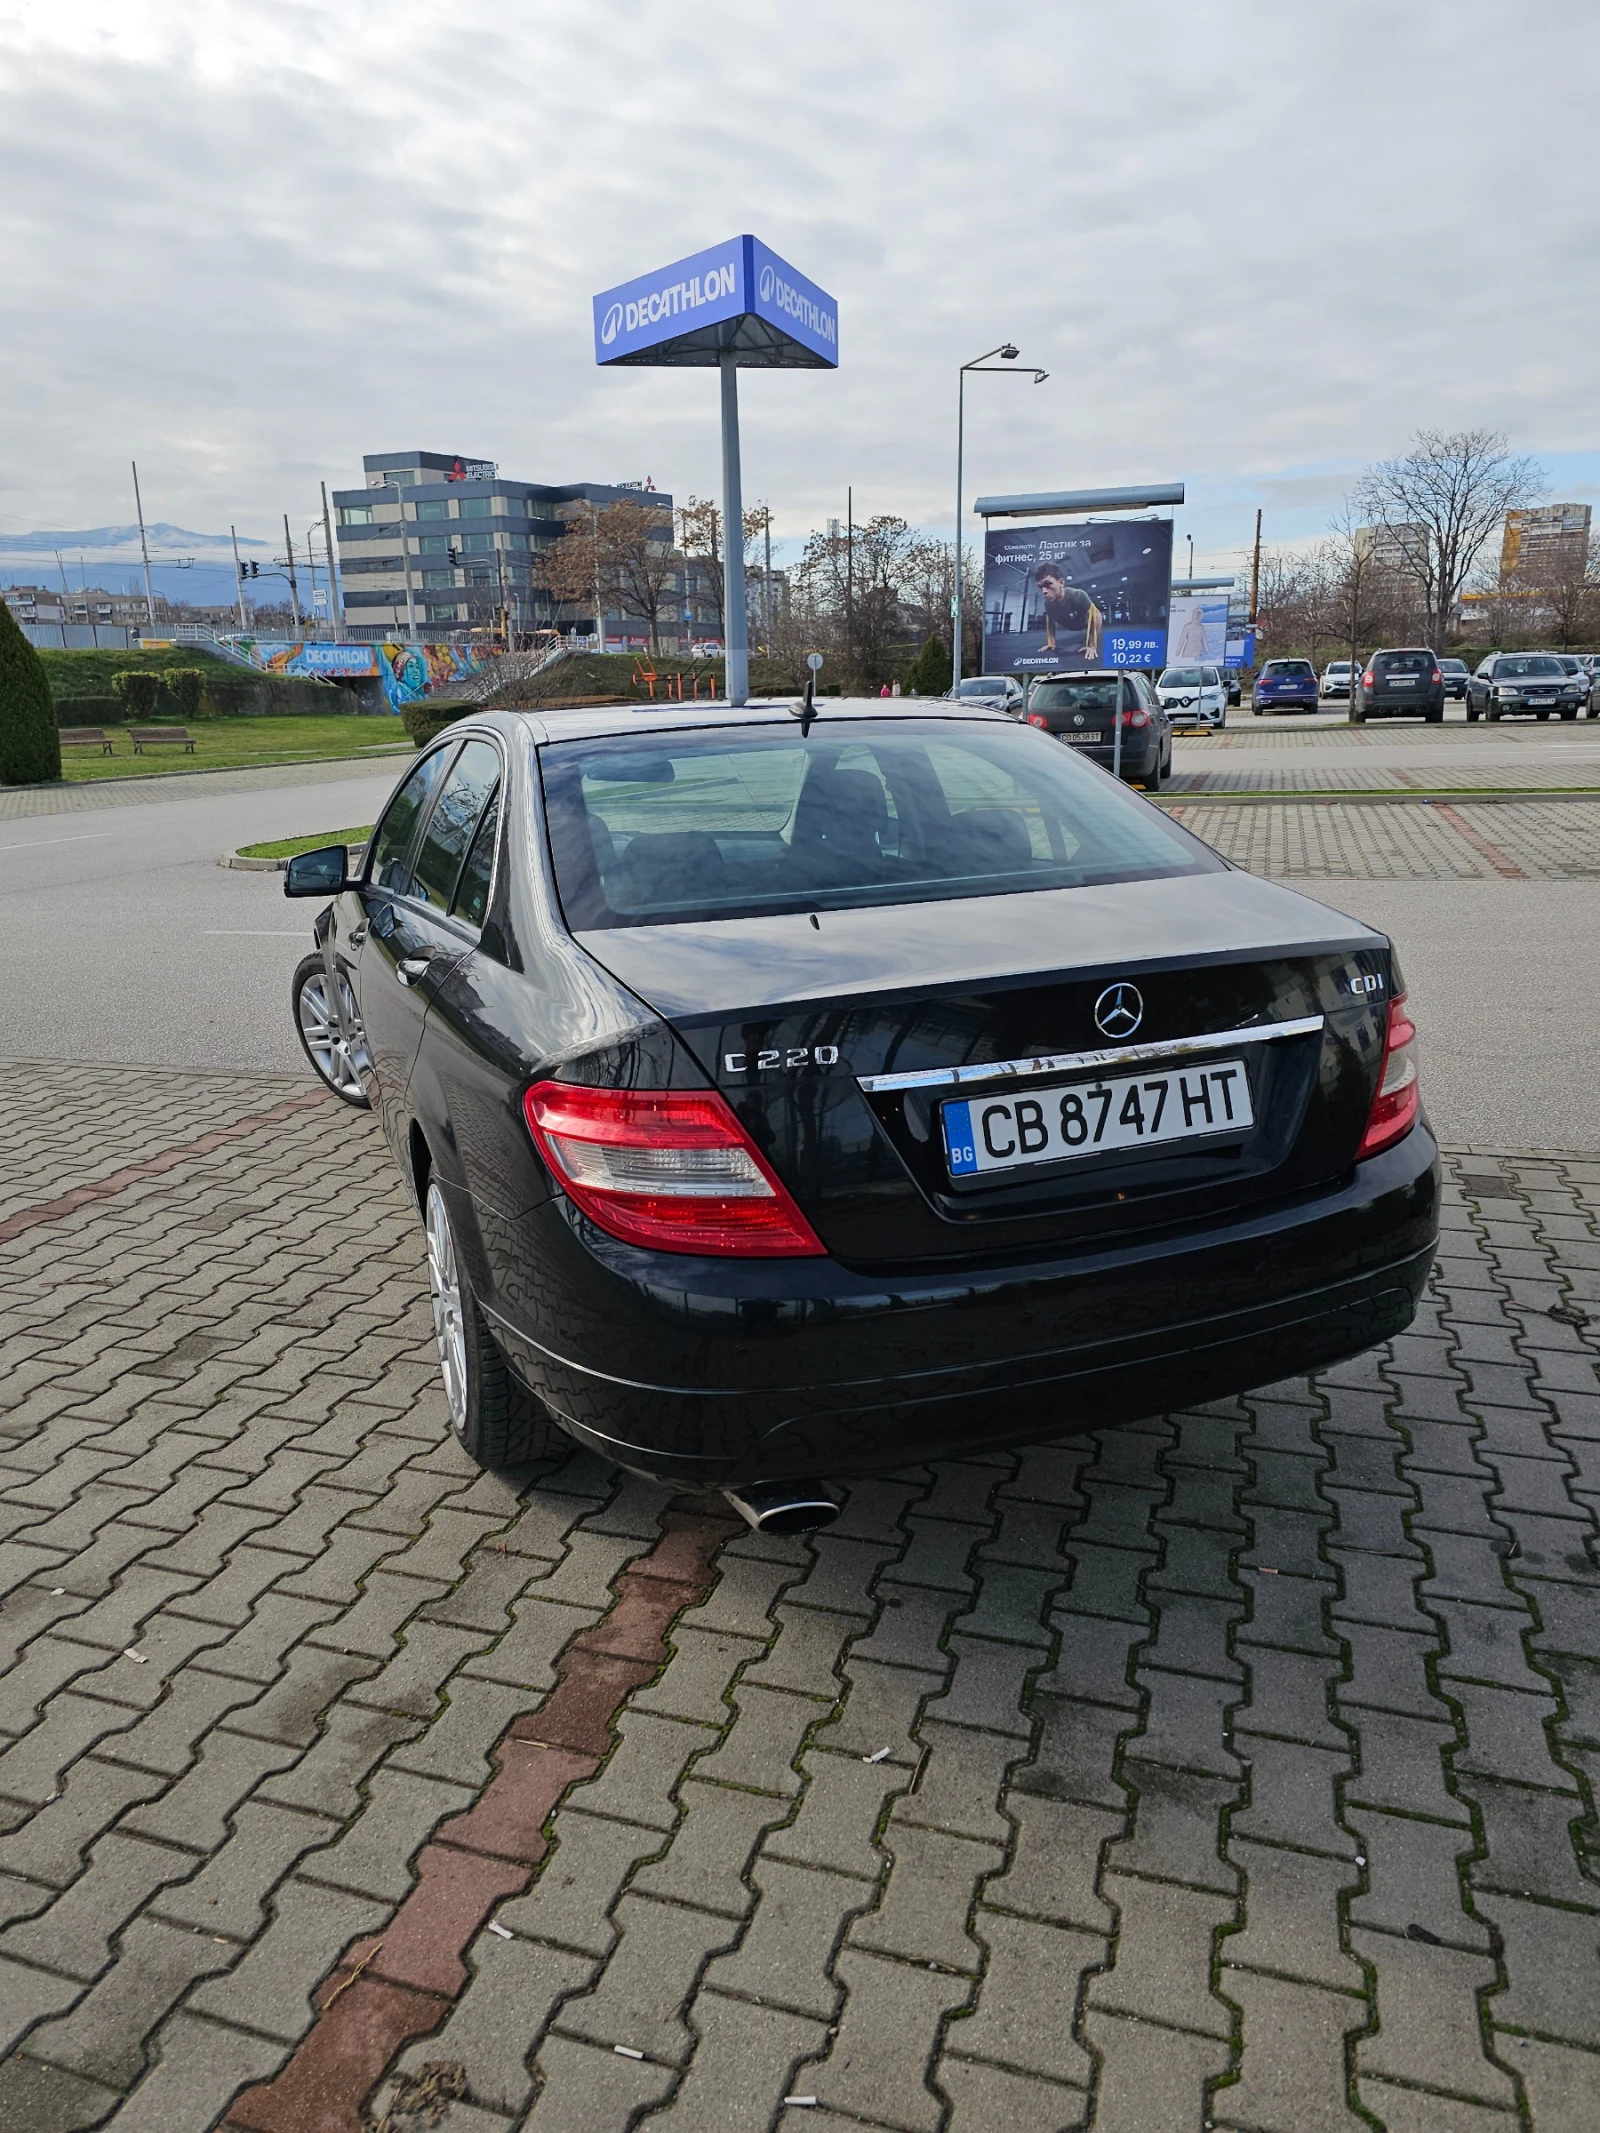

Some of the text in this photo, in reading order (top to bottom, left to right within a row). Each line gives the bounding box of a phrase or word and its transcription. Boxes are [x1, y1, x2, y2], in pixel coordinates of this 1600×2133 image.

[626, 263, 735, 332] DECATHLON
[776, 277, 835, 344] DECATHLON
[1038, 540, 1077, 550] Ластик
[1080, 540, 1091, 548] за
[995, 551, 1065, 565] фитнес, 25 кг
[1112, 638, 1159, 651] 19,99 лв.
[305, 649, 369, 665] DECATHLON
[1022, 657, 1059, 665] DECATHLON
[1112, 652, 1151, 665] 10,22 €
[1350, 973, 1384, 995] CDI
[725, 1045, 839, 1073] C 220
[981, 1069, 1238, 1159] CB 8747 HT
[951, 1146, 974, 1165] BG
